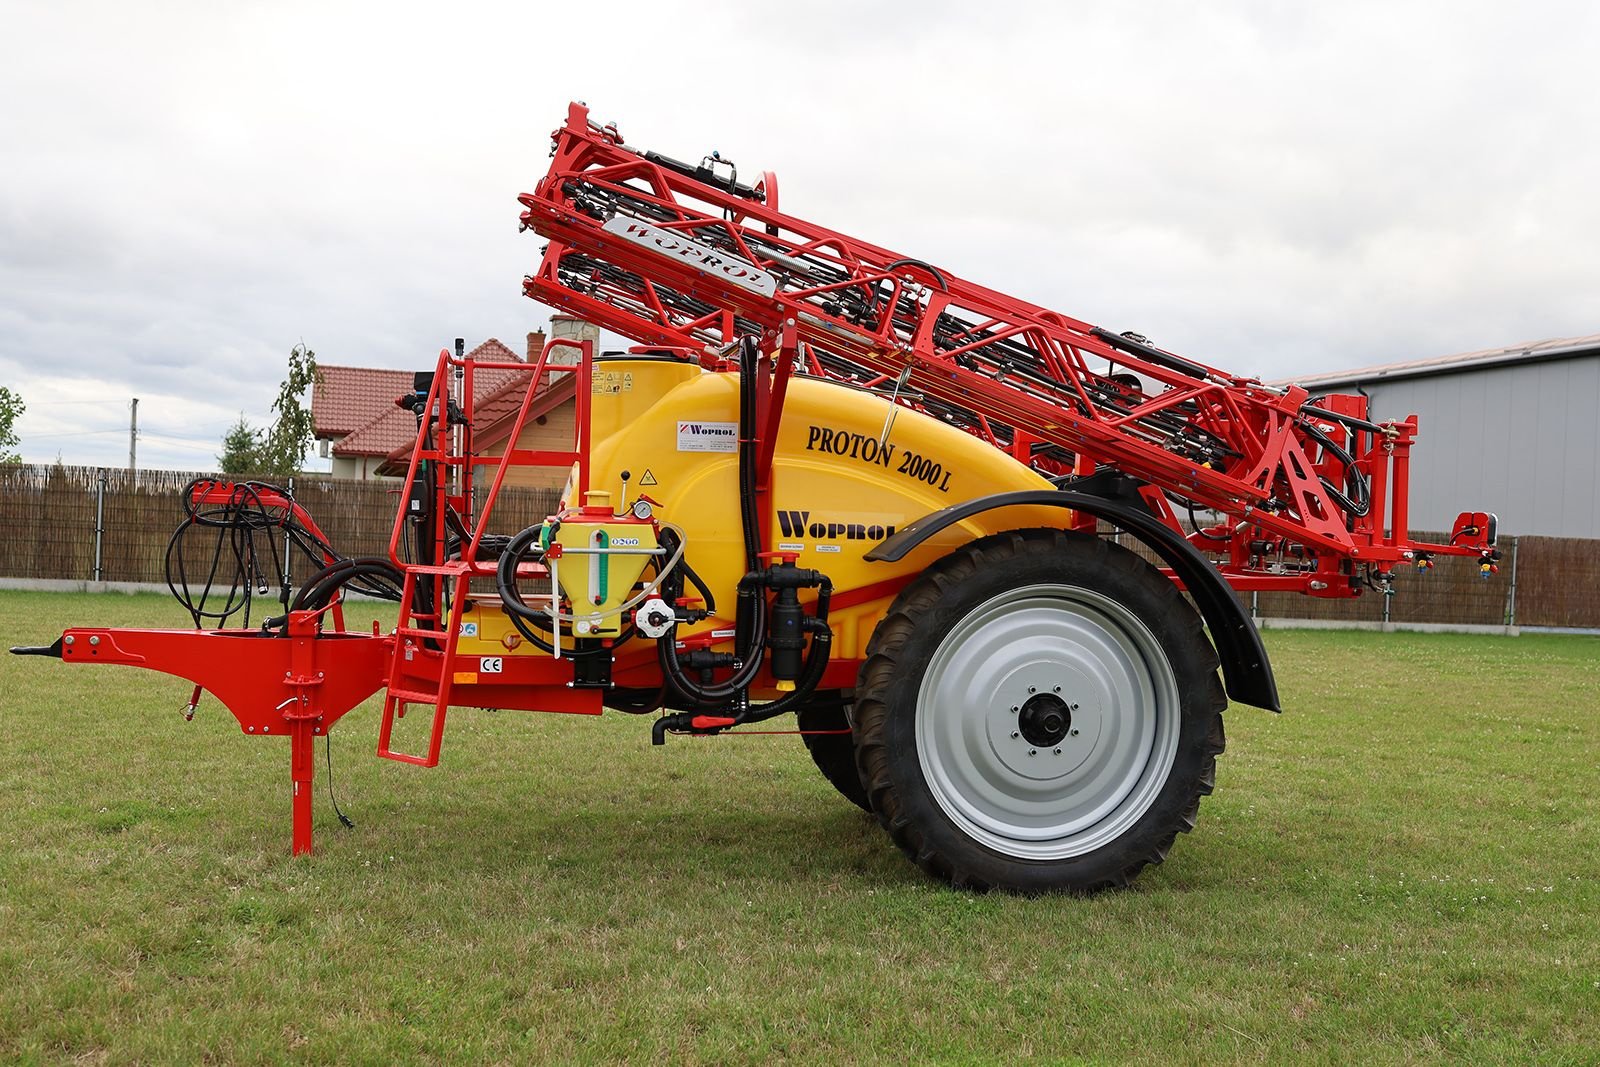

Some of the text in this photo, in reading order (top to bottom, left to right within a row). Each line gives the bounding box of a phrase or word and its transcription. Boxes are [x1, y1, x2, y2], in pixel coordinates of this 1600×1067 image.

[626, 223, 765, 288] WOPROL
[690, 424, 736, 436] WOPROL
[806, 425, 952, 493] PROTON 2000 L
[482, 658, 501, 672] CE
